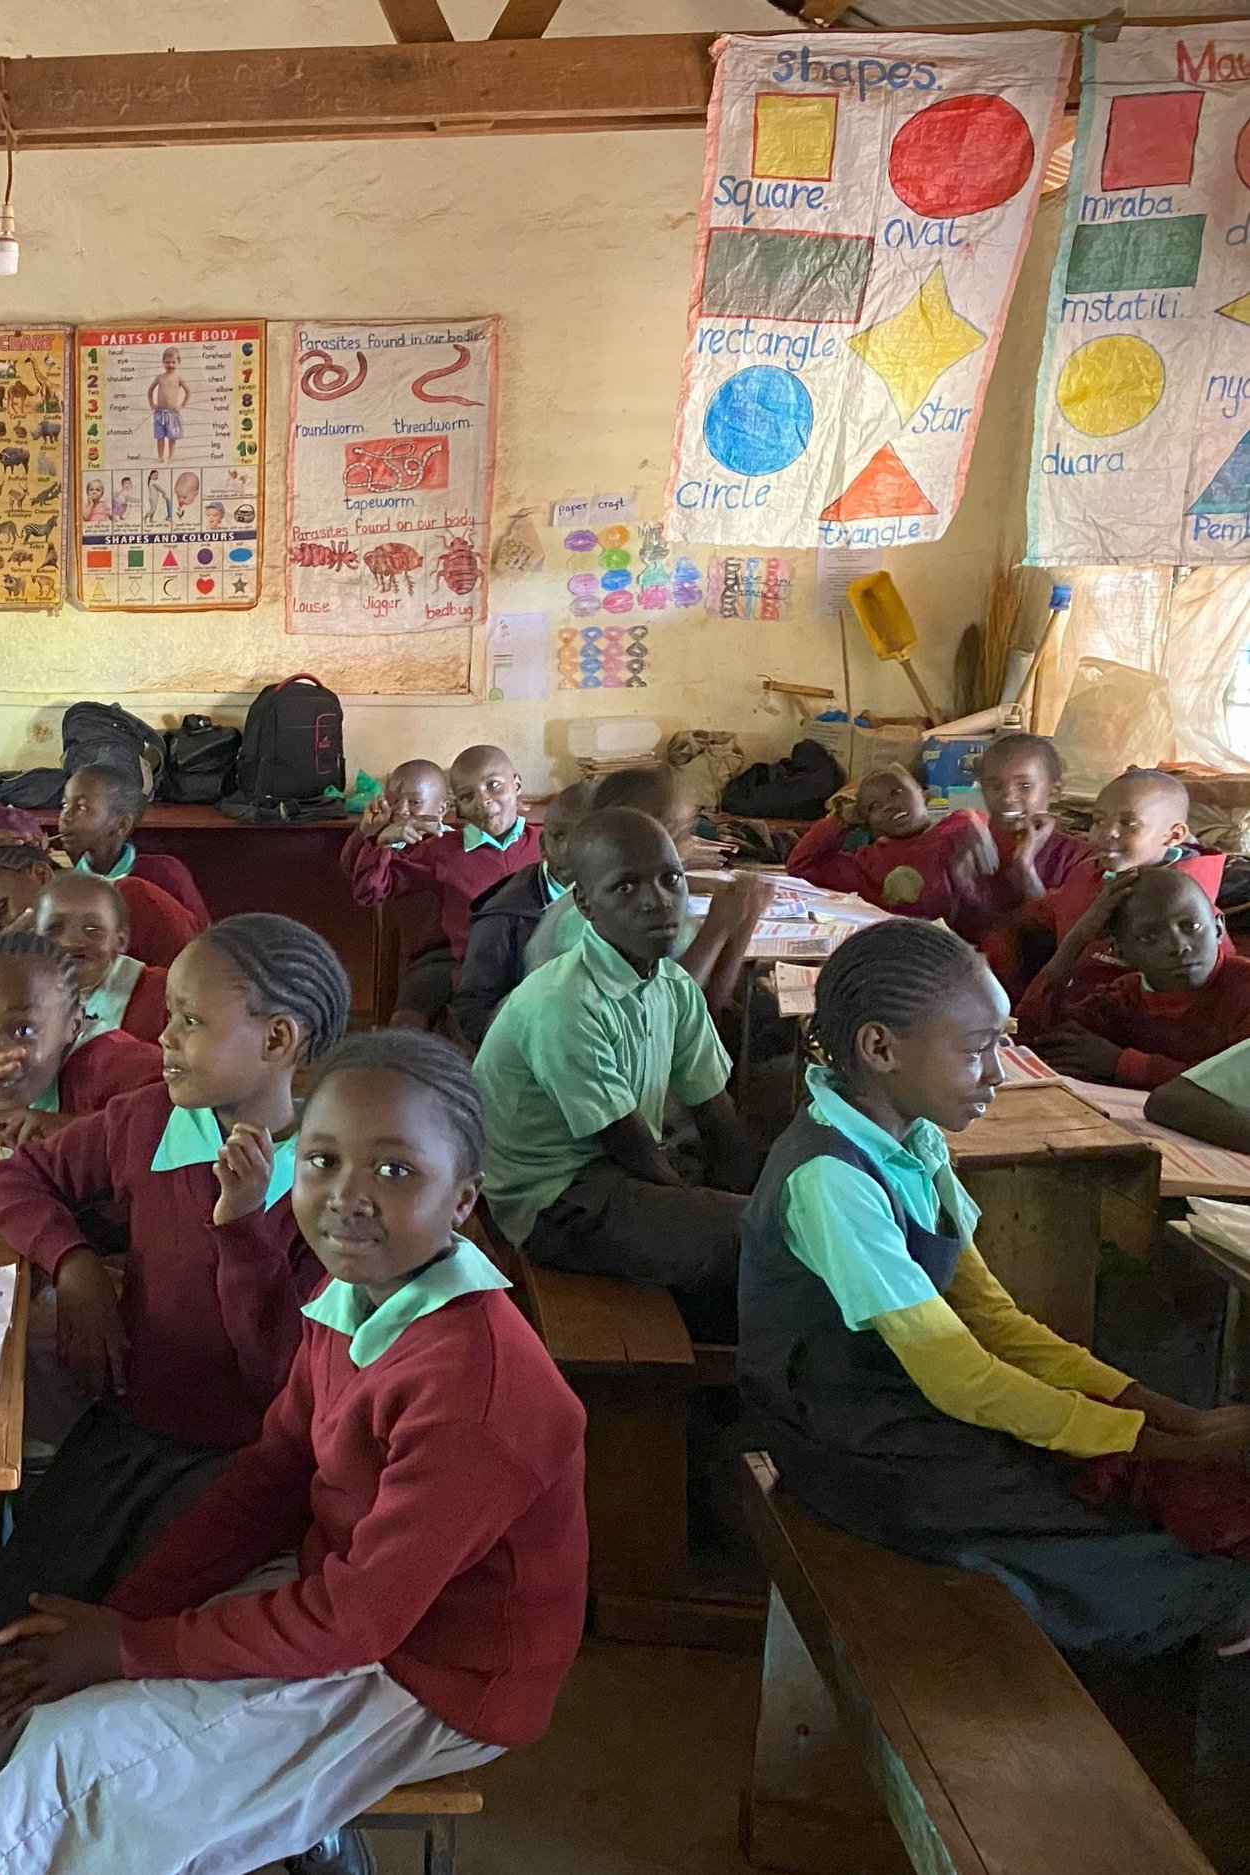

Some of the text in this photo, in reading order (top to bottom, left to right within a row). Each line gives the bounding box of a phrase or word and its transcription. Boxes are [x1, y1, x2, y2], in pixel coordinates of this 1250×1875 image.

[101, 329, 238, 345] PARTS OF THE BODY
[300, 331, 360, 350] Parasites
[368, 333, 405, 348] found
[411, 336, 422, 345] in
[425, 334, 444, 344] our
[559, 497, 625, 516] paper craft
[292, 508, 475, 541] Parasites found on our body
[105, 531, 235, 545] SHAPES AND COLOURS
